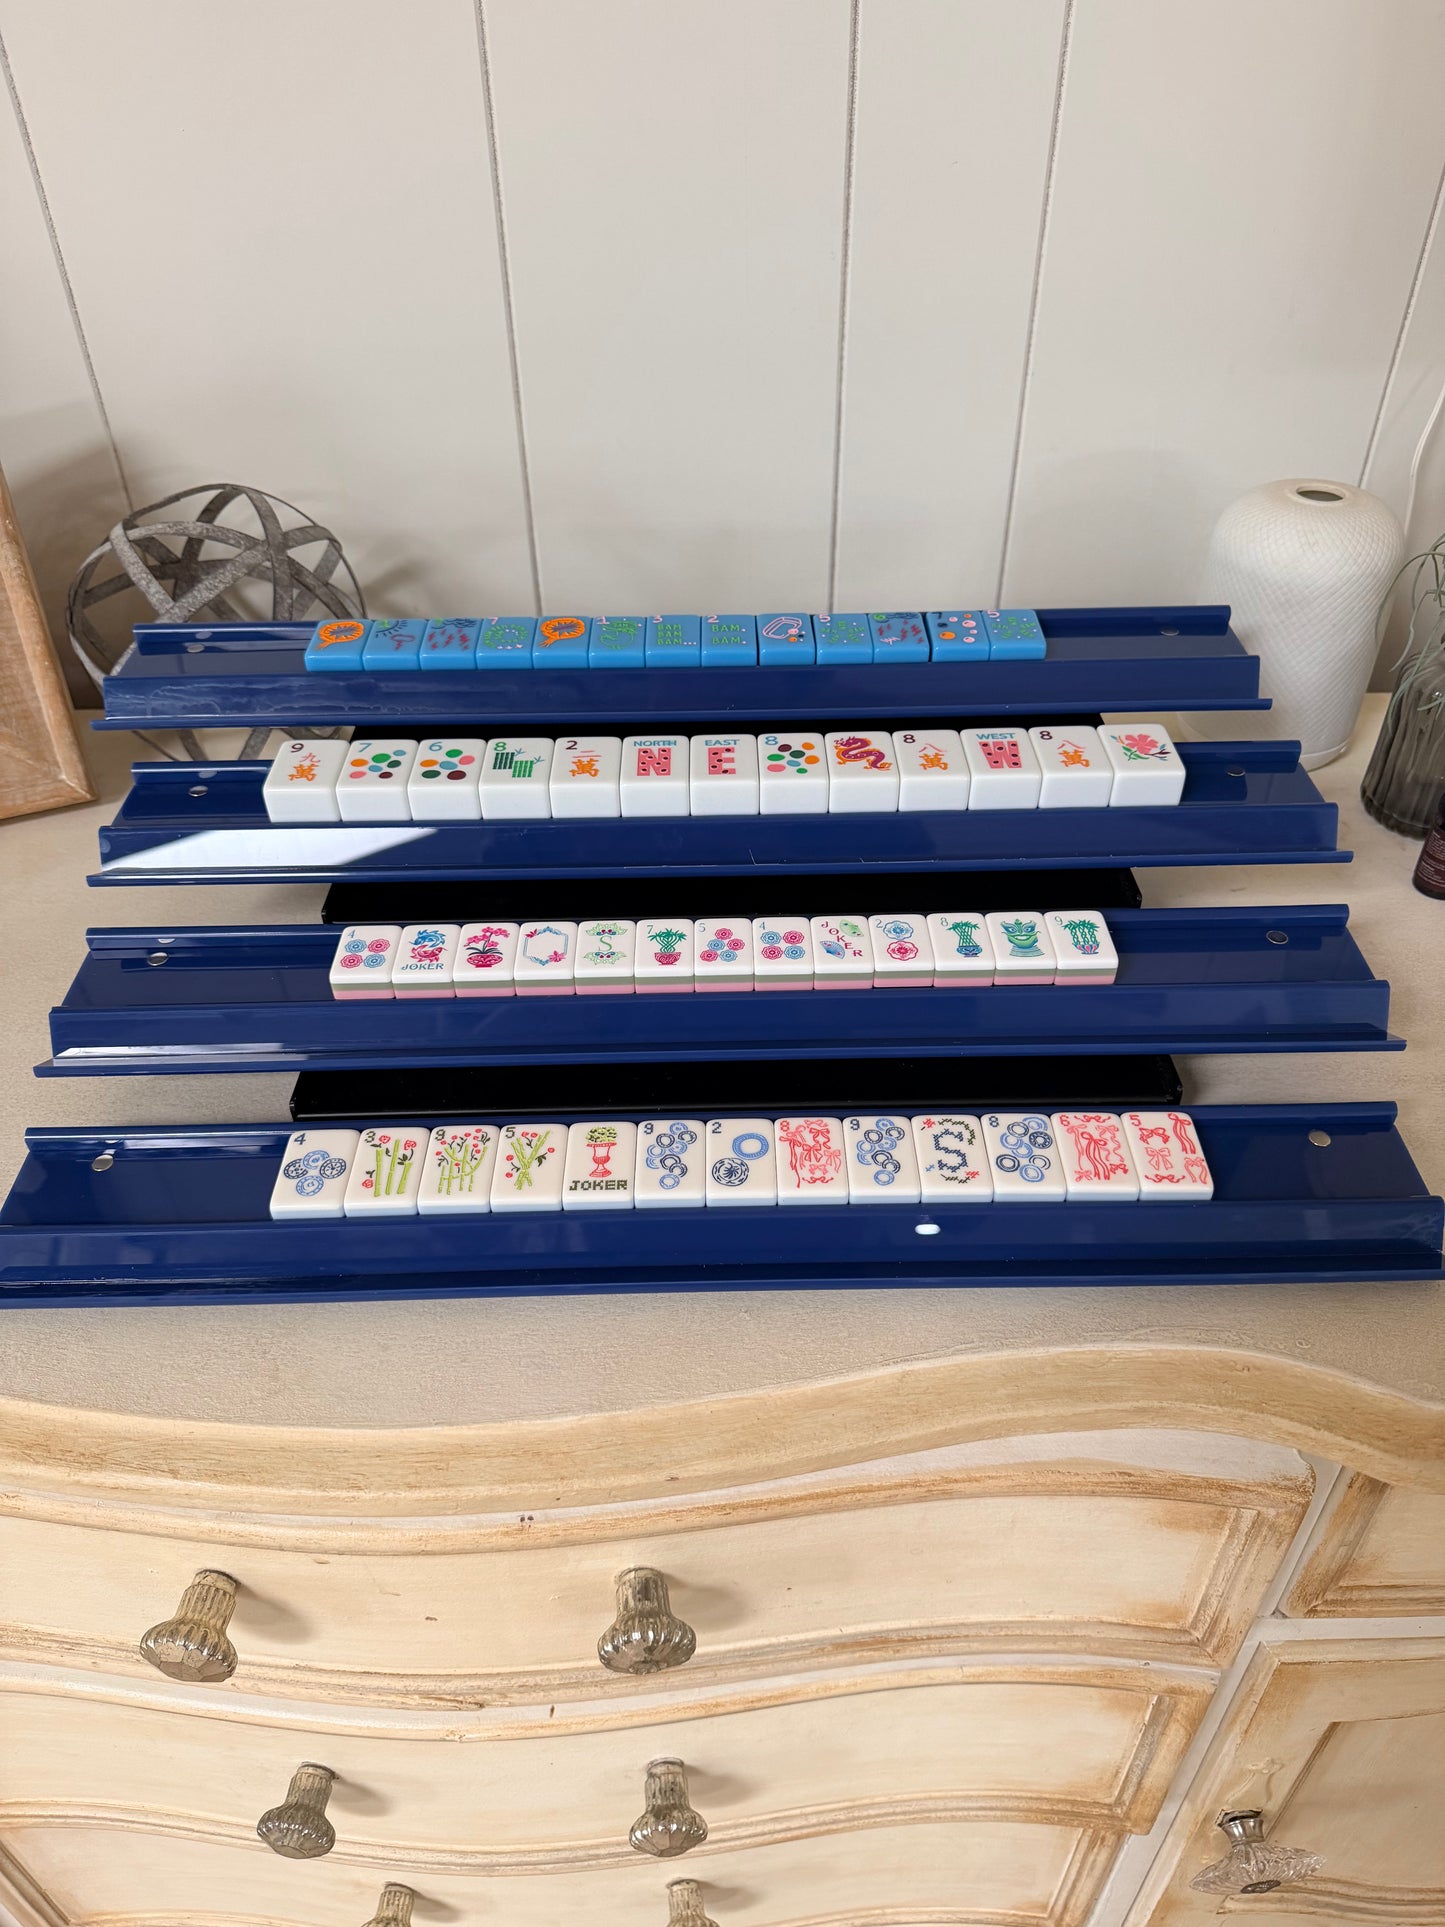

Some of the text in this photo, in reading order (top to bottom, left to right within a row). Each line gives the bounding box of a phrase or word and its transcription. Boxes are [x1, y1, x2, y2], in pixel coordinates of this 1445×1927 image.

[652, 614, 663, 624] 3
[707, 614, 719, 623] 2
[818, 614, 831, 623] 5
[986, 610, 1000, 618] 5
[488, 616, 498, 625] 7
[903, 734, 916, 744] 8
[976, 732, 1017, 741] WEST
[1040, 731, 1053, 740] 8
[565, 740, 578, 750] 2
[704, 739, 740, 747] EAST
[765, 736, 779, 746] 8
[290, 743, 305, 753] 9
[358, 742, 372, 753] 7
[429, 741, 443, 752] 6
[494, 742, 507, 751] 8
[978, 740, 1022, 769] W
[637, 747, 672, 777] N
[707, 747, 737, 775] E
[875, 919, 884, 929] 2
[940, 917, 949, 926] 8
[1054, 915, 1063, 925] 9
[646, 925, 654, 935] 7
[698, 922, 706, 932] 5
[759, 921, 766, 930] 4
[347, 928, 355, 938] 4
[599, 935, 613, 952] S
[401, 963, 445, 971] JOKER
[989, 1115, 1000, 1128] 8
[1059, 1114, 1071, 1127] 6
[1129, 1114, 1142, 1127] 5
[643, 1123, 654, 1135] 9
[711, 1122, 722, 1134] 2
[780, 1120, 790, 1132] 8
[364, 1131, 375, 1143] 3
[505, 1126, 516, 1139] 5
[294, 1133, 306, 1145] 4
[569, 1179, 628, 1191] JOKER
